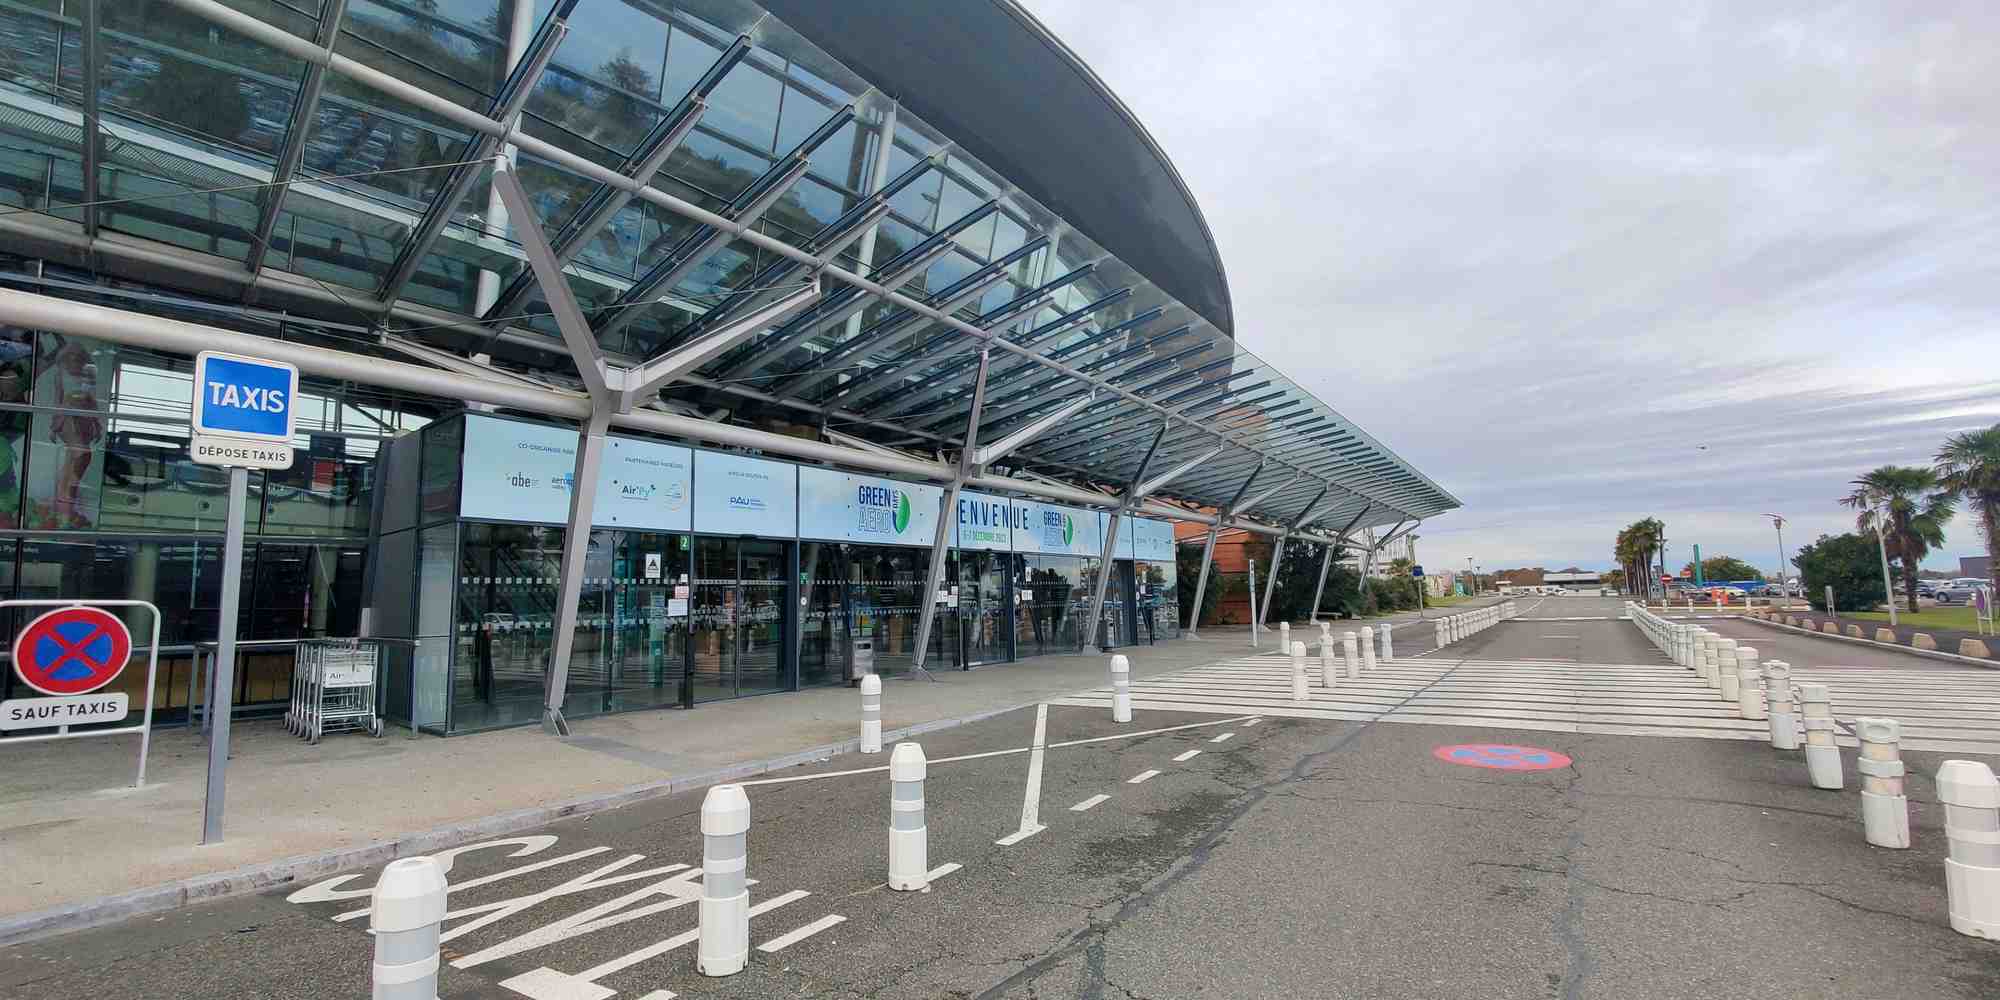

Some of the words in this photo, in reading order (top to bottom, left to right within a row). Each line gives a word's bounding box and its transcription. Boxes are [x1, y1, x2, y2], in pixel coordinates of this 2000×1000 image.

[208, 381, 285, 413] TAXIS
[199, 445, 248, 459] DÉPOSE
[252, 450, 286, 462] TAXIS
[512, 472, 531, 487] abe
[859, 486, 891, 507] GREEN
[1043, 511, 1062, 527] GREEN
[11, 705, 61, 721] SAUF
[66, 701, 118, 716] TAXIS
